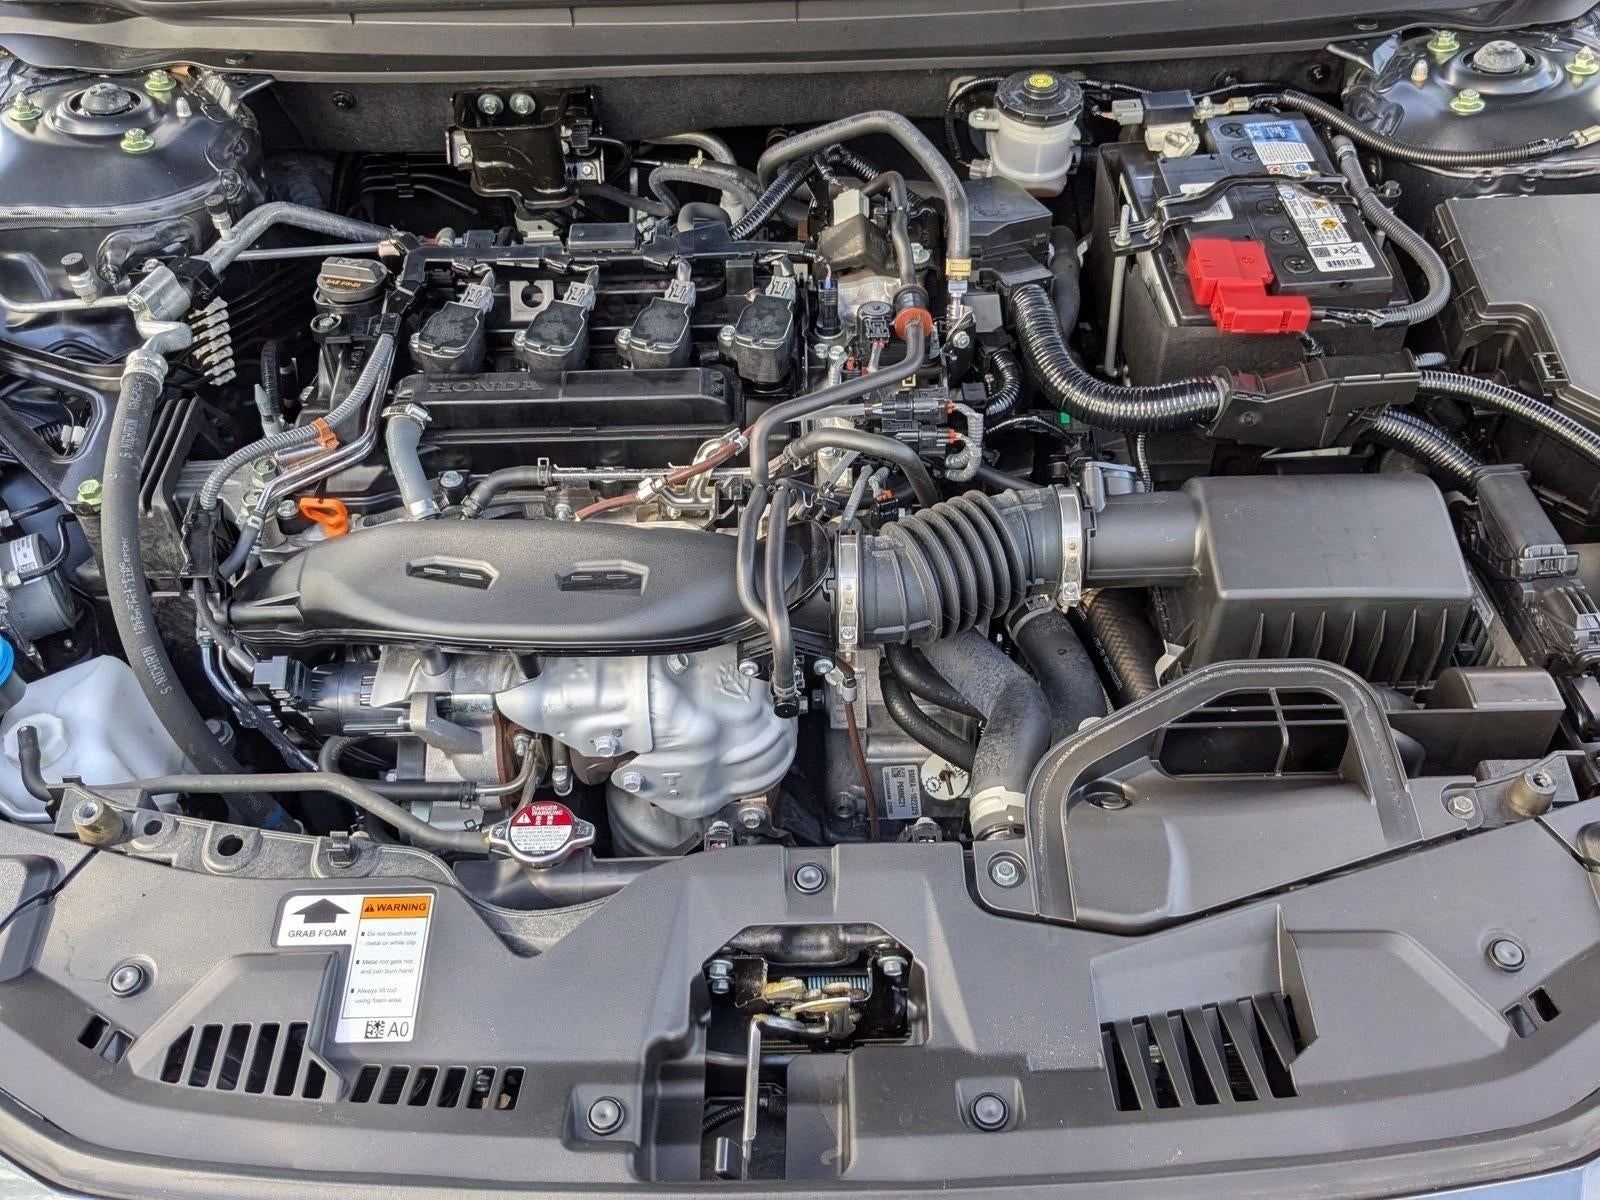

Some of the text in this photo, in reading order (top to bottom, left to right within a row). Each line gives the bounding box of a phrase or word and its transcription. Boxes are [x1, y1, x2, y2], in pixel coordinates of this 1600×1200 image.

[427, 380, 543, 393] HONDA
[376, 903, 427, 912] WARNING
[288, 929, 347, 938] GRAB FOAM
[387, 1021, 409, 1037] A0
